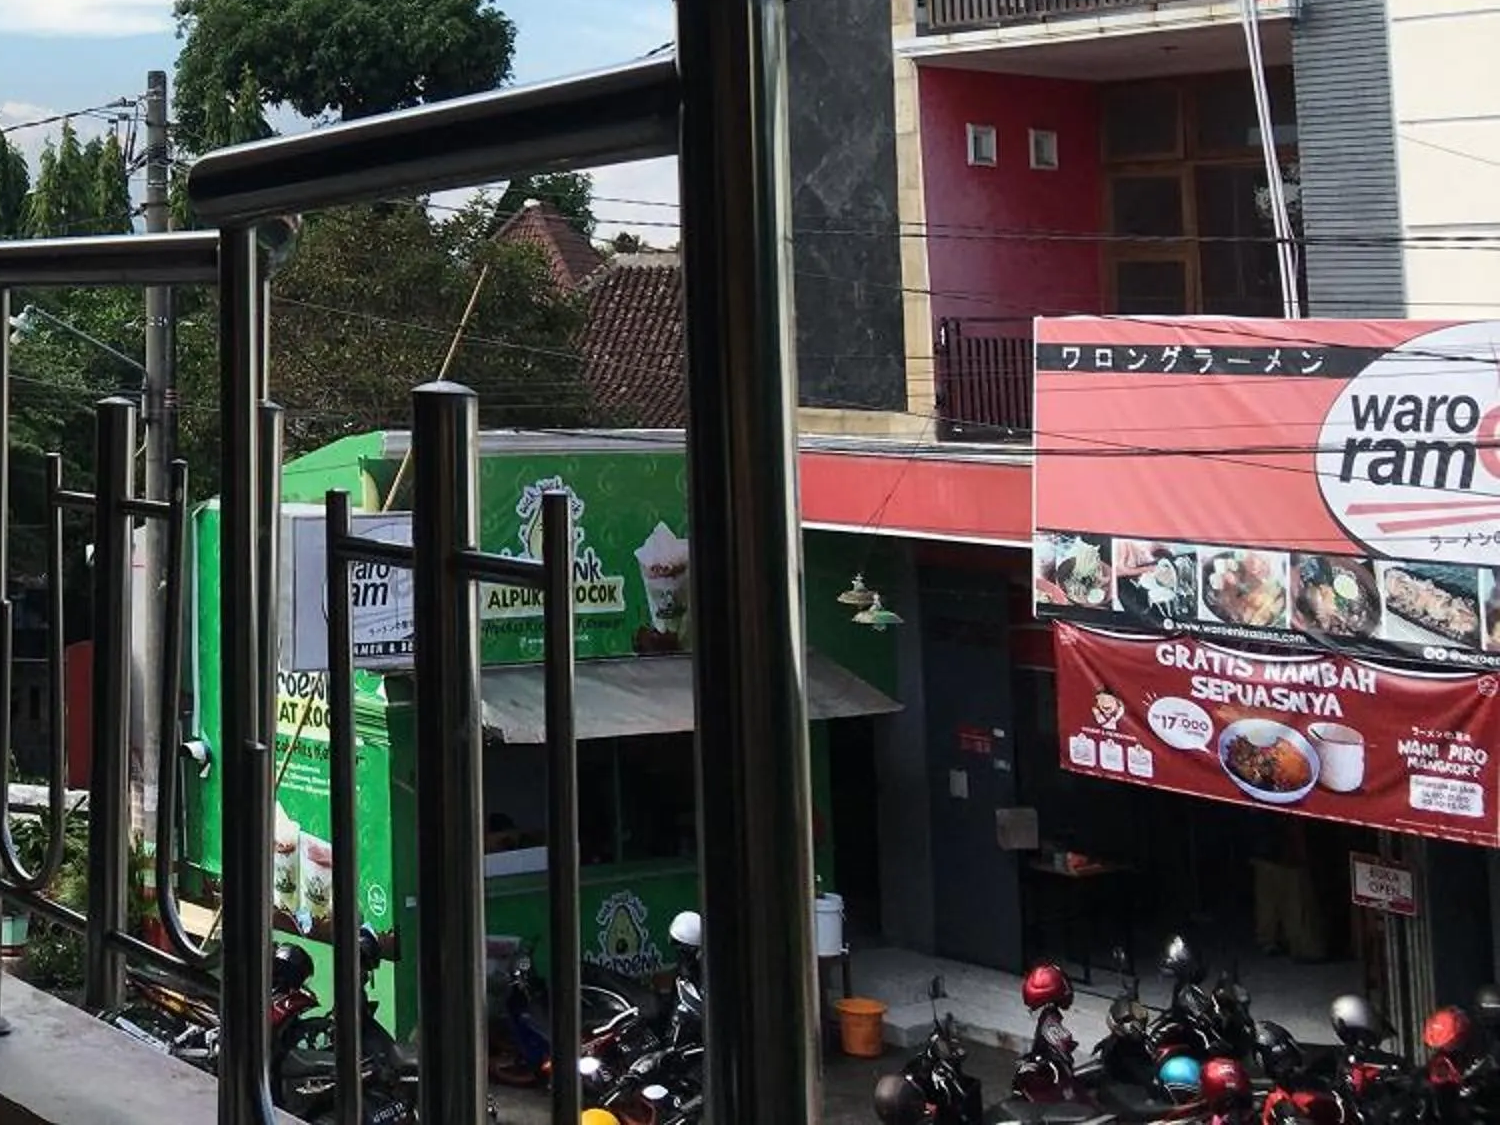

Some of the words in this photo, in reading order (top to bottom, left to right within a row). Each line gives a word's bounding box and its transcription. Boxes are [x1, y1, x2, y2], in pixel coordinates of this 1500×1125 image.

[1062, 345, 1325, 373] ワロングラーメン
[354, 561, 390, 580] aro
[352, 581, 389, 607] am
[488, 585, 544, 610] ALPUK
[575, 583, 618, 605] OCOK
[1155, 643, 1254, 678] GRATIS
[1263, 662, 1377, 694] NAMBAH
[1191, 676, 1345, 717] SEPUASNYA
[1448, 743, 1489, 766] PIRO
